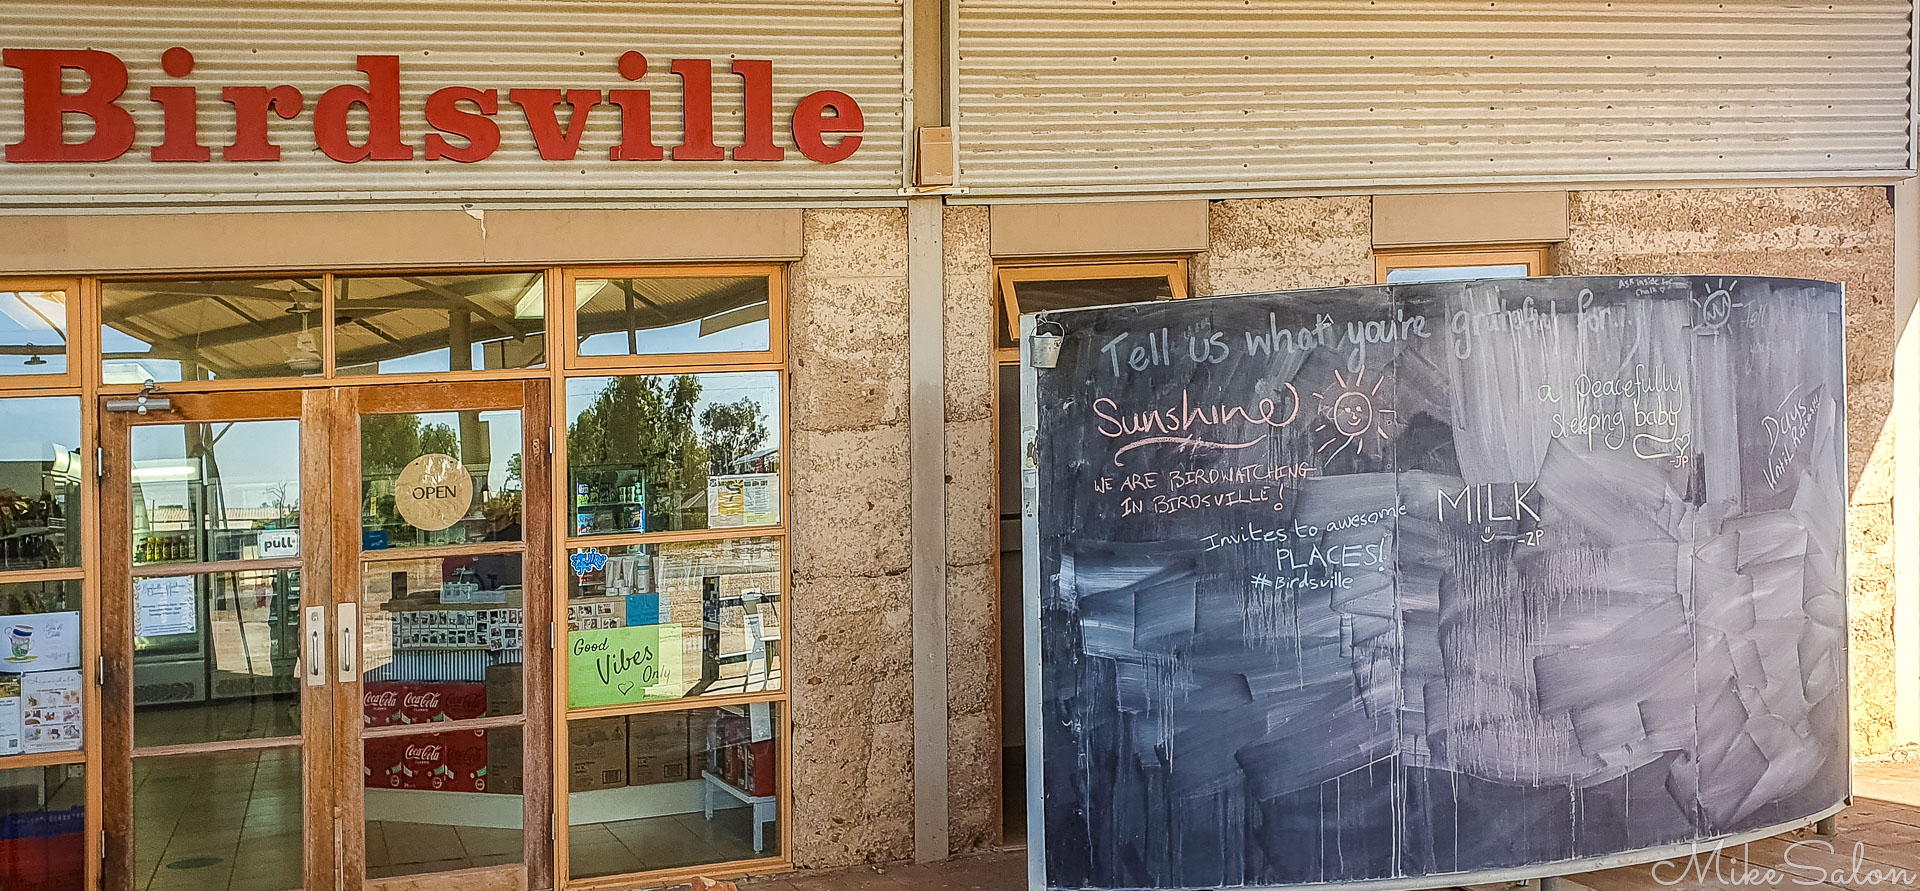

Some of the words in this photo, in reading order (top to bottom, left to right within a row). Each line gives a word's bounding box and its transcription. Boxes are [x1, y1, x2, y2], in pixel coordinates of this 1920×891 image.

[3, 46, 865, 163] Birdsville
[1101, 328, 1170, 377] Tell
[1189, 330, 1231, 364] us
[1245, 311, 1327, 357] what
[1346, 308, 1432, 374] you're
[1093, 382, 1300, 438] Sunshine
[1537, 384, 1562, 403] a
[1633, 395, 1679, 443] baby
[1761, 398, 1807, 456] Days
[412, 485, 457, 500] OPEN
[1093, 476, 1114, 494] WE
[1119, 472, 1159, 492] ARE
[1168, 461, 1318, 491] BIRDWATCHING
[1120, 496, 1144, 517] IN
[1437, 479, 1542, 525] MILK
[264, 536, 293, 552] pull
[1200, 521, 1288, 552] Invites
[1294, 518, 1319, 538] to
[1325, 503, 1408, 532] awesome
[1276, 537, 1388, 573] PLACES!
[573, 637, 609, 656] Good
[596, 645, 653, 685] Vibes
[642, 664, 671, 683] Only
